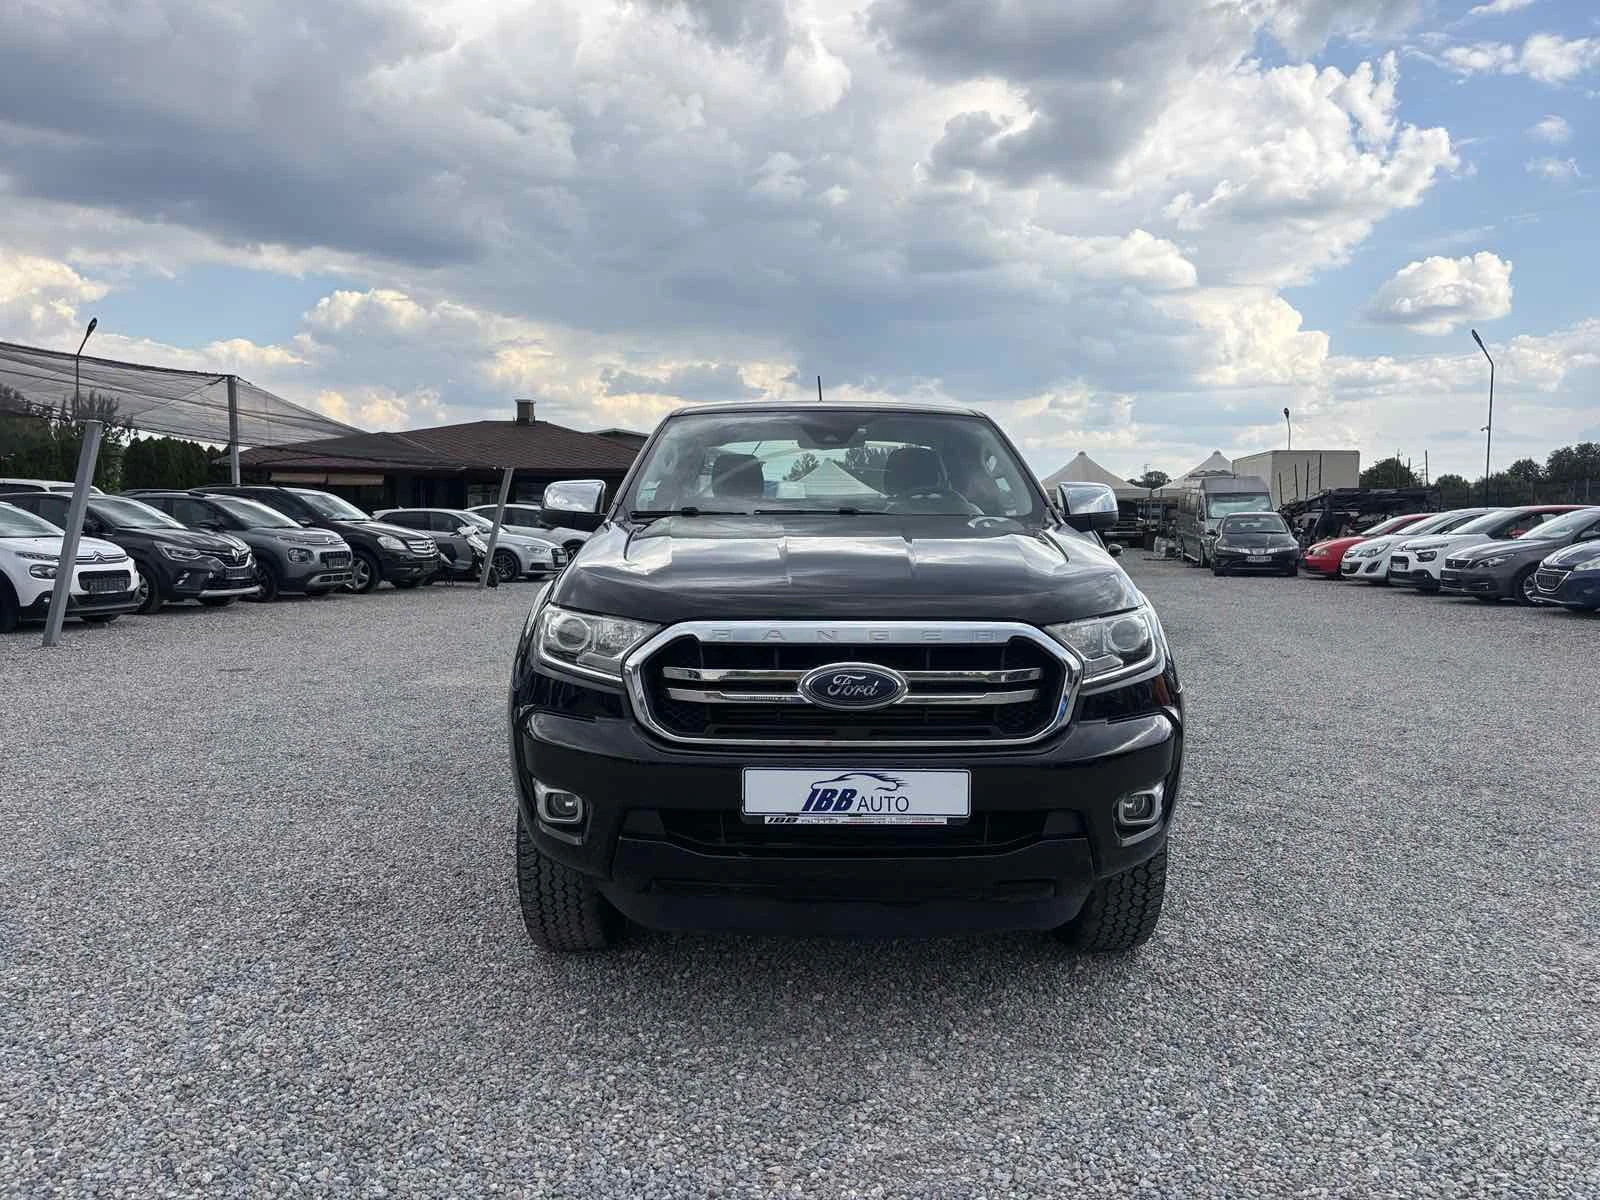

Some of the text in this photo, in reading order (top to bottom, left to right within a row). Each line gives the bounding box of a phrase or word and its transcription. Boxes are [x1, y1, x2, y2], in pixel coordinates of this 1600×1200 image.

[711, 629, 999, 641] RANGER
[828, 674, 879, 696] Ford
[801, 788, 909, 812] IBB AUTO
